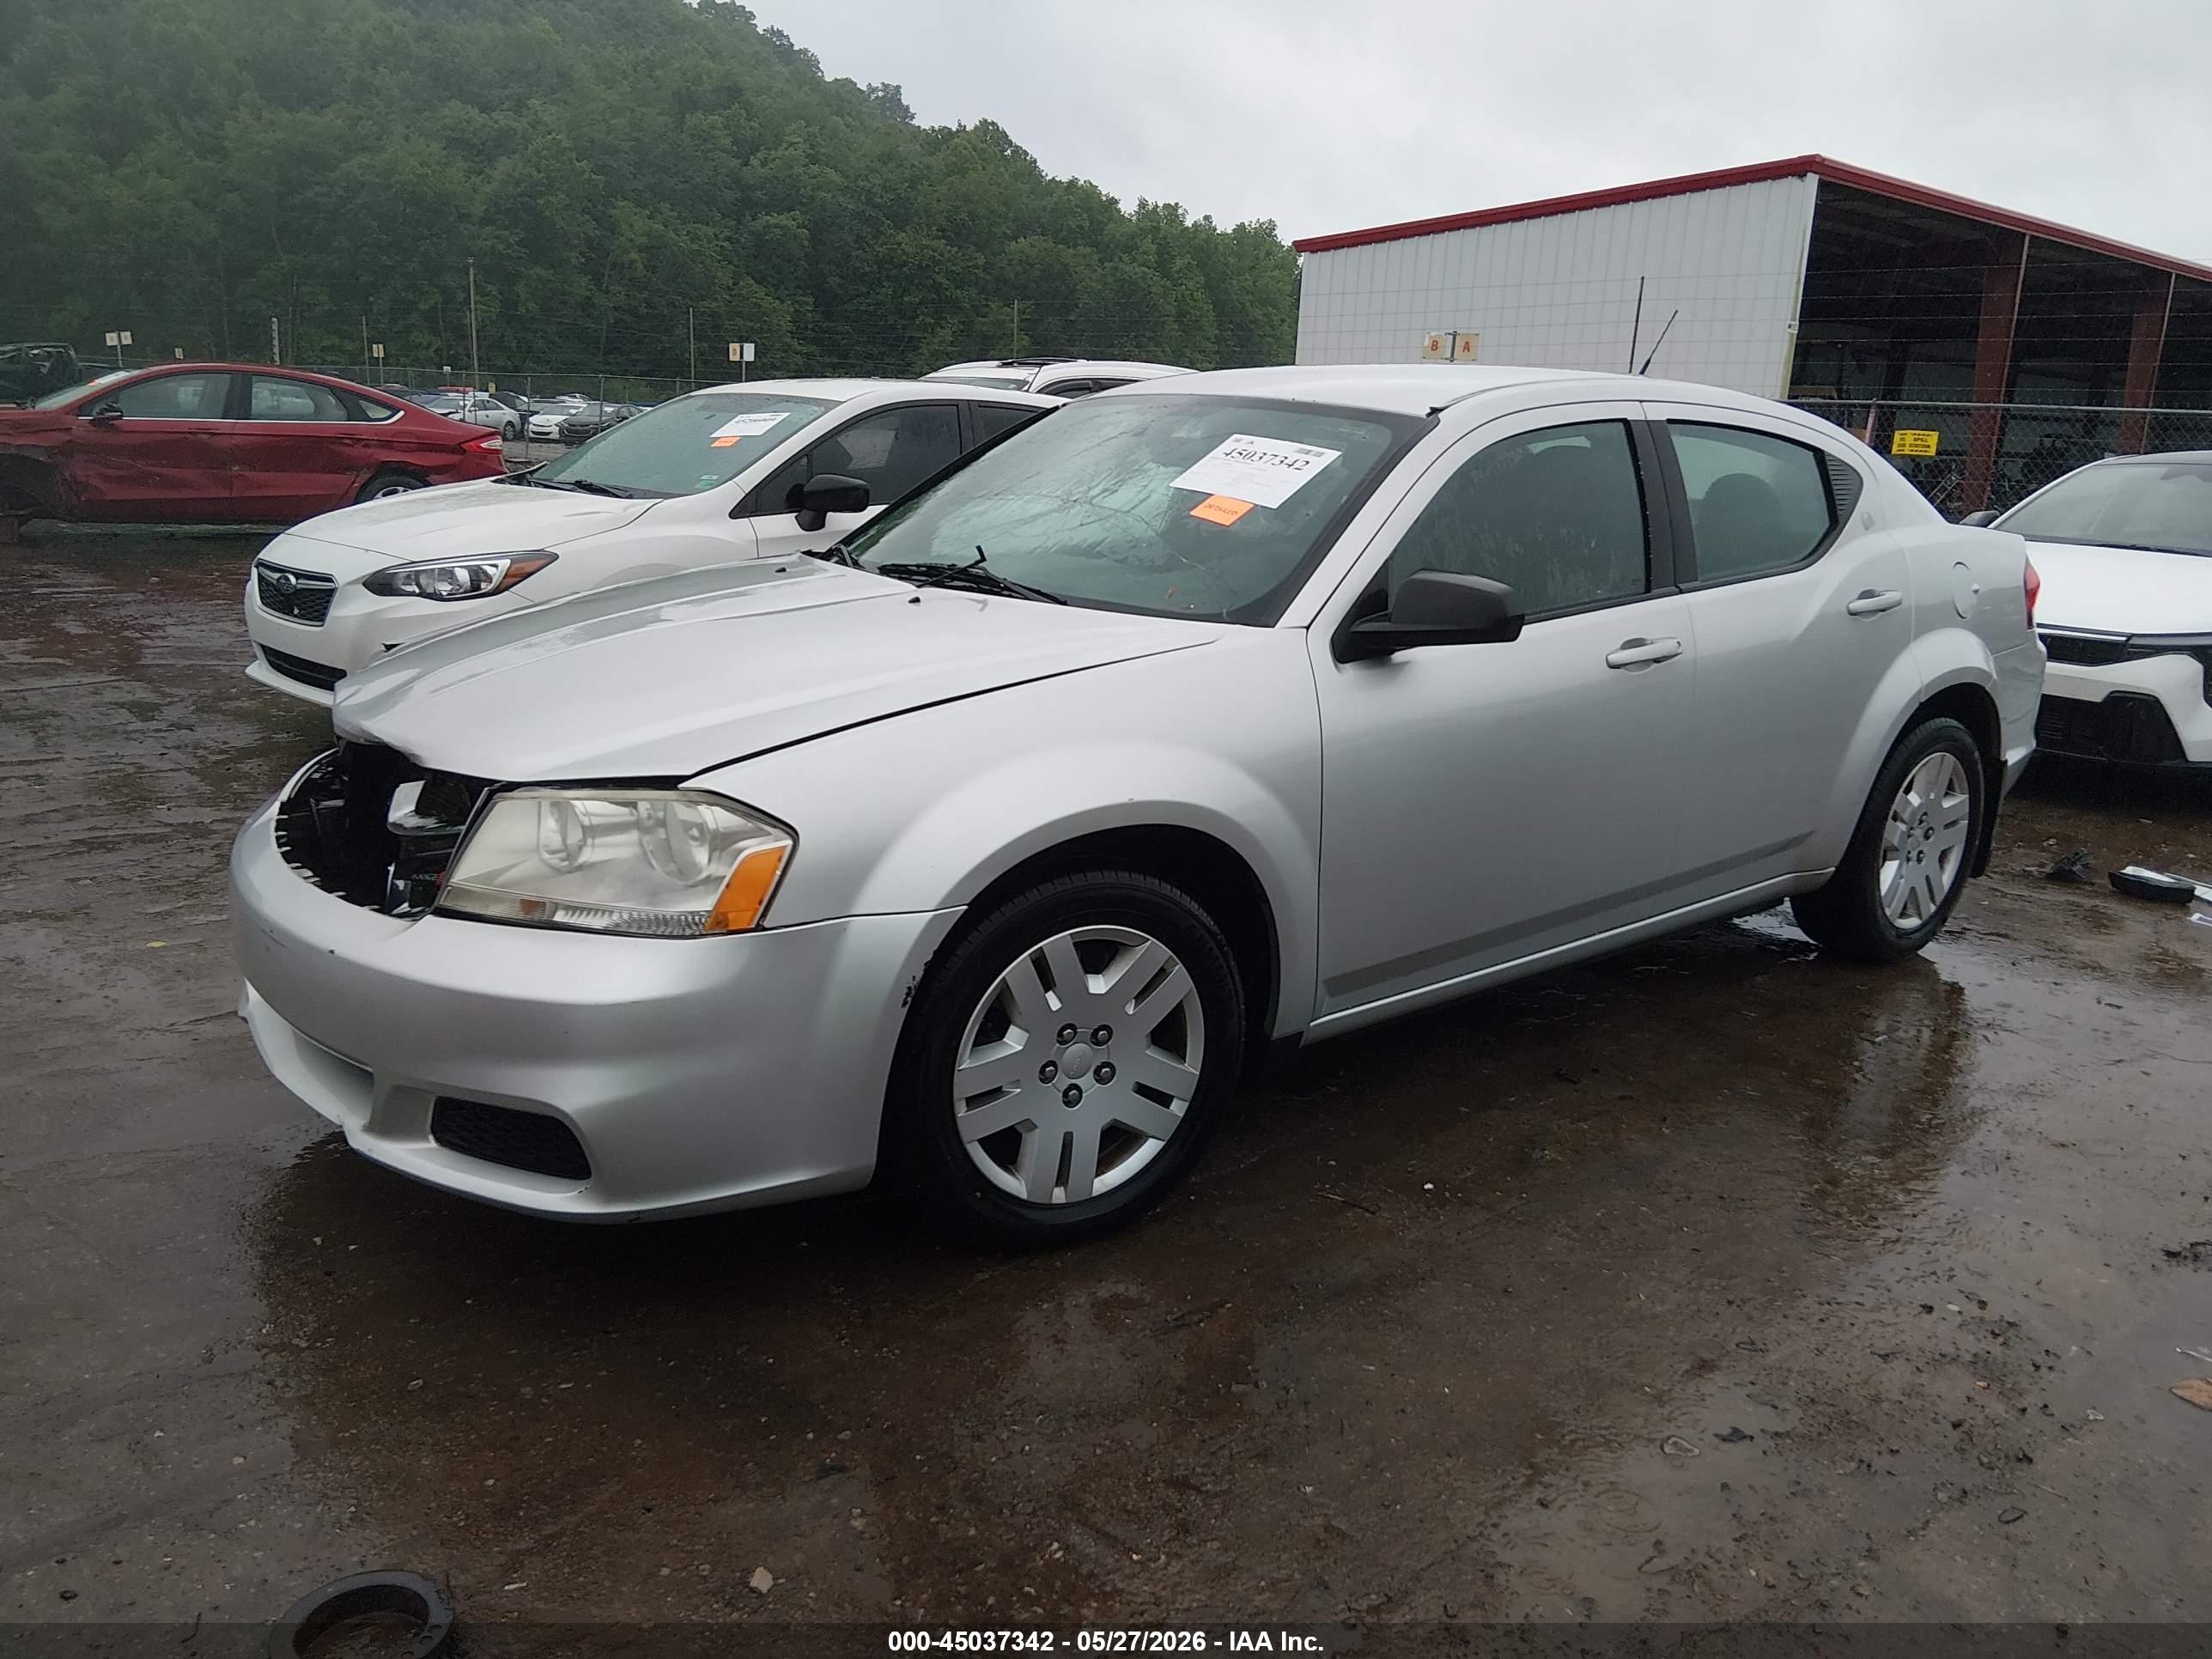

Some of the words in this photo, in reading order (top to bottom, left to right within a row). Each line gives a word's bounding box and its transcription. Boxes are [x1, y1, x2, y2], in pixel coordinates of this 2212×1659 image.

[1430, 339, 1439, 351] B
[1462, 341, 1471, 353] A
[1223, 447, 1310, 471] 45037342
